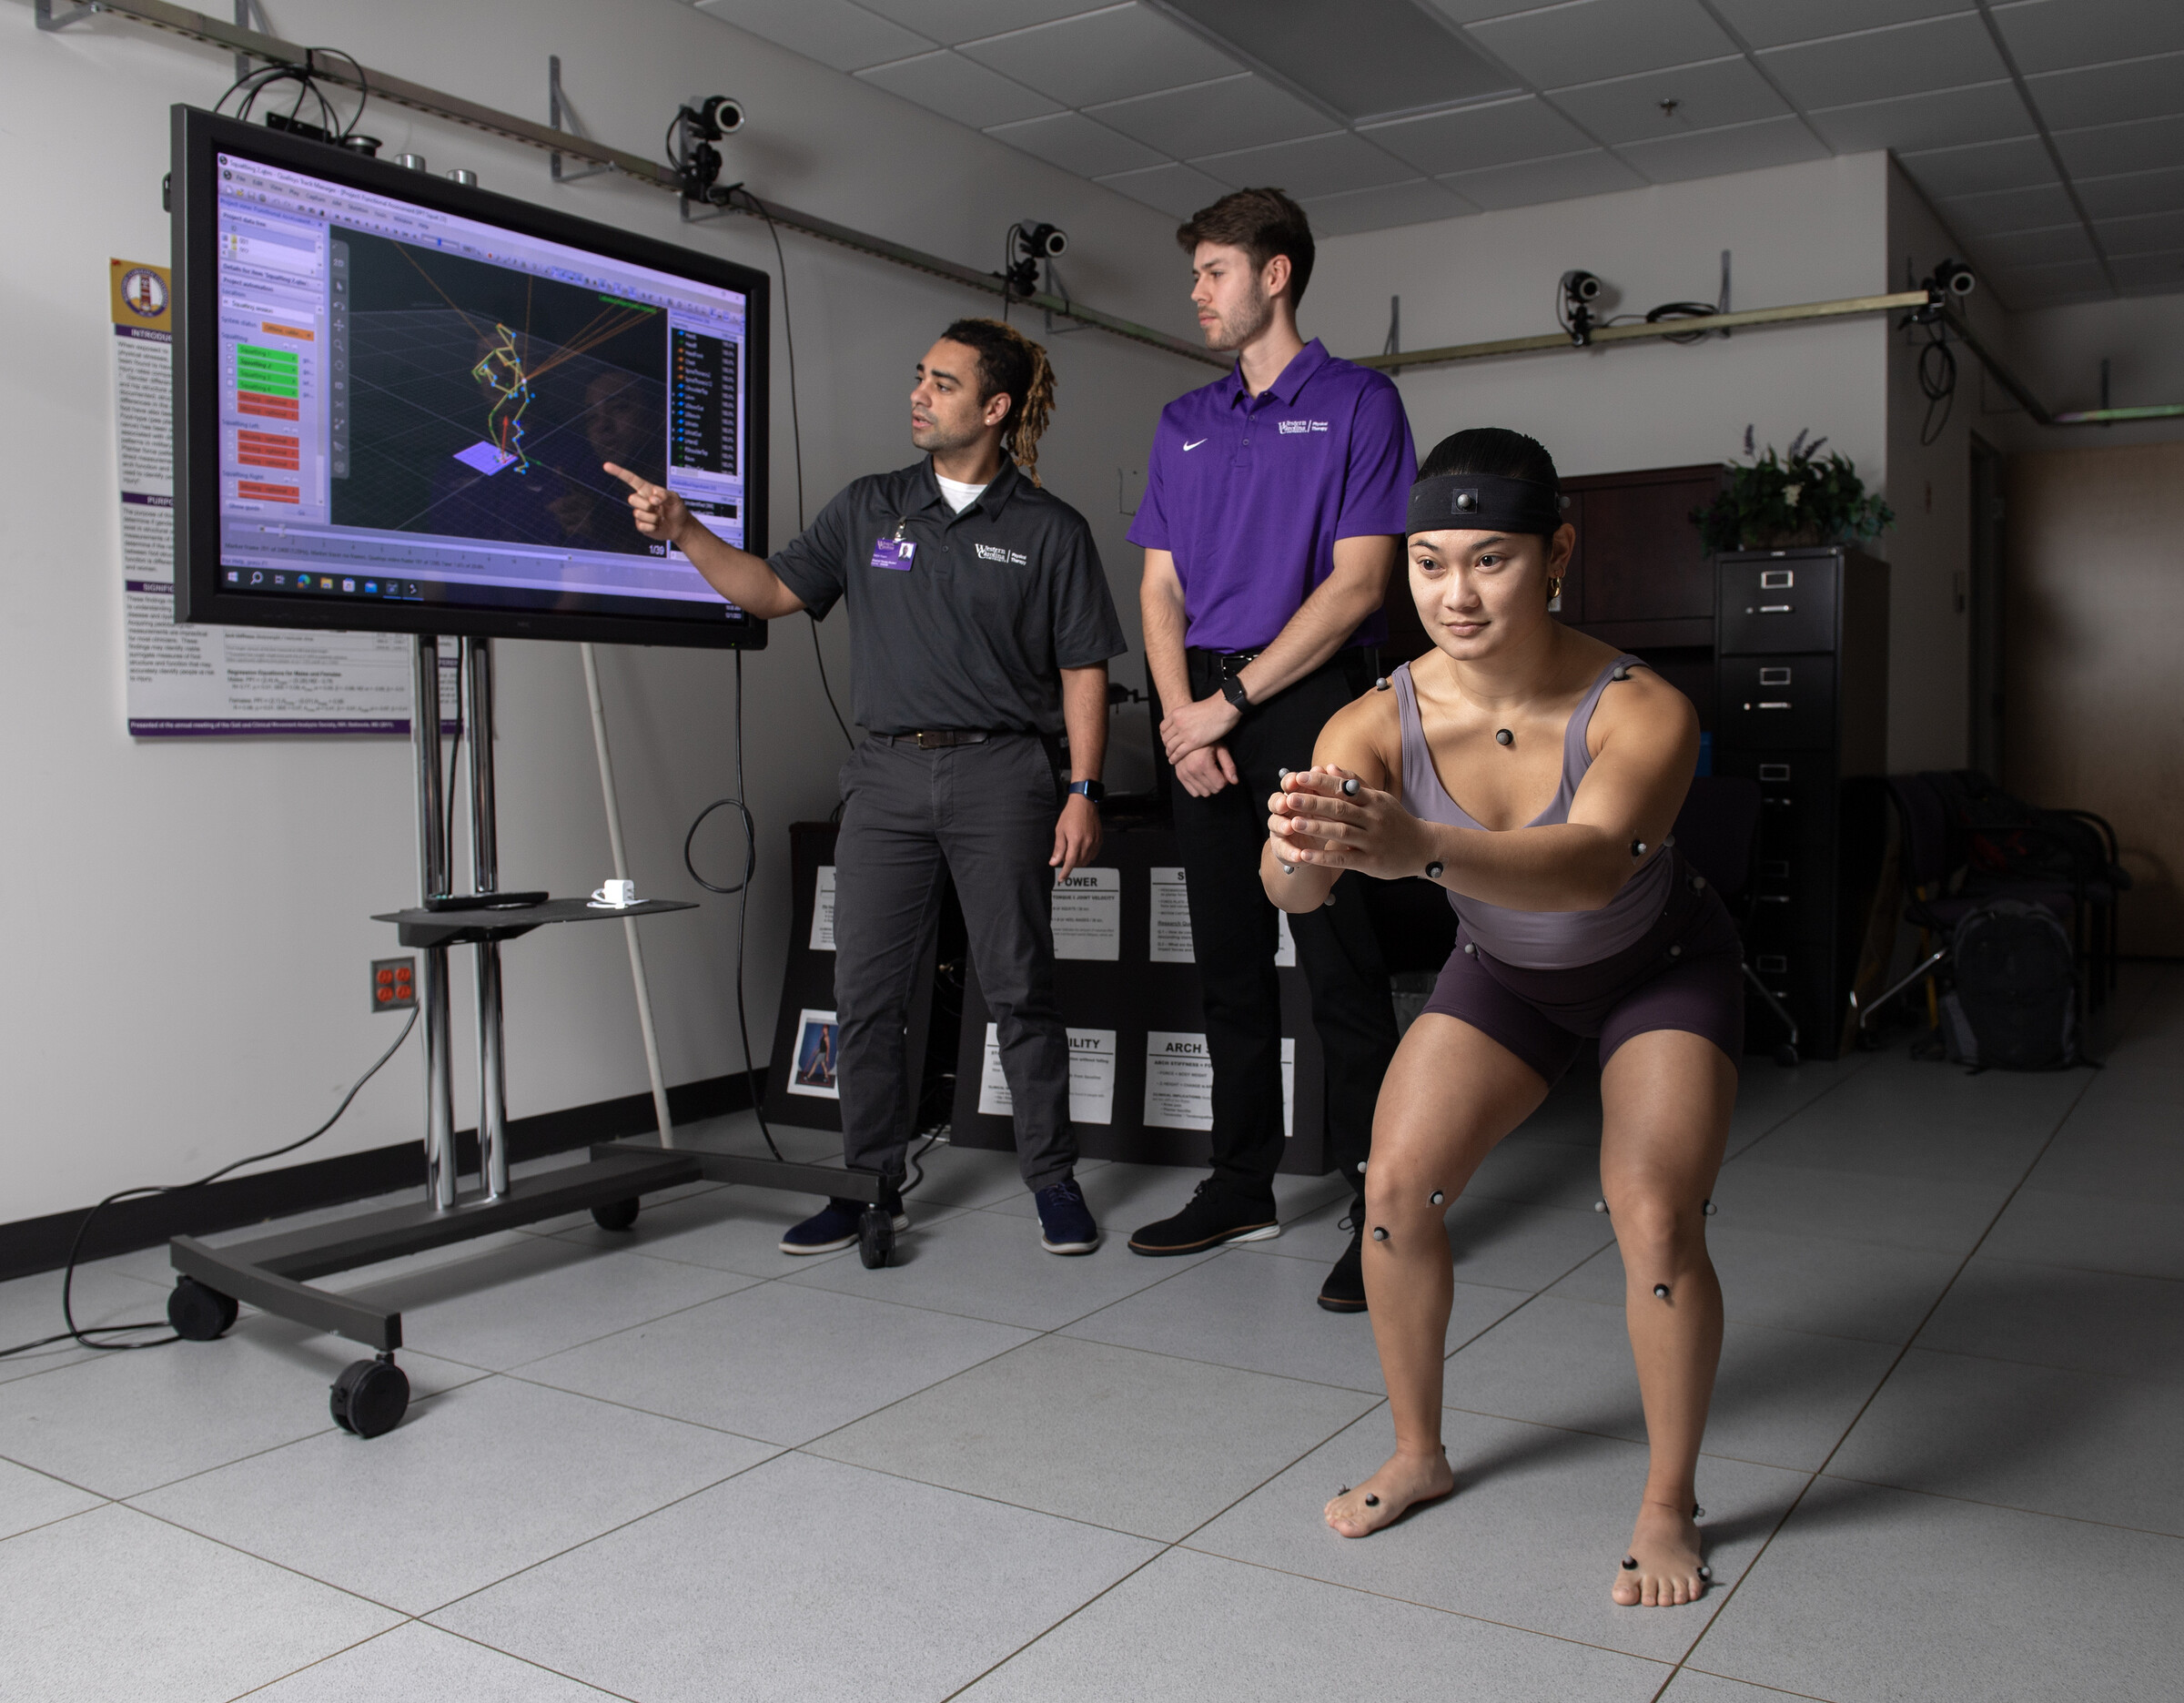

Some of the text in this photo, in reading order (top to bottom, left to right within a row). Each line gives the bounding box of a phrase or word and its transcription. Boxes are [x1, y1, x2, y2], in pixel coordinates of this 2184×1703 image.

[236, 173, 246, 183] File
[252, 177, 262, 188] Edit
[269, 182, 282, 192] View
[288, 188, 298, 197] Play
[313, 181, 335, 194] Manager
[223, 211, 266, 228] Project data tree
[223, 262, 240, 272] Details
[223, 277, 273, 293] Project automation
[649, 544, 665, 555] 1/39
[1166, 1042, 1201, 1053] ARCH
